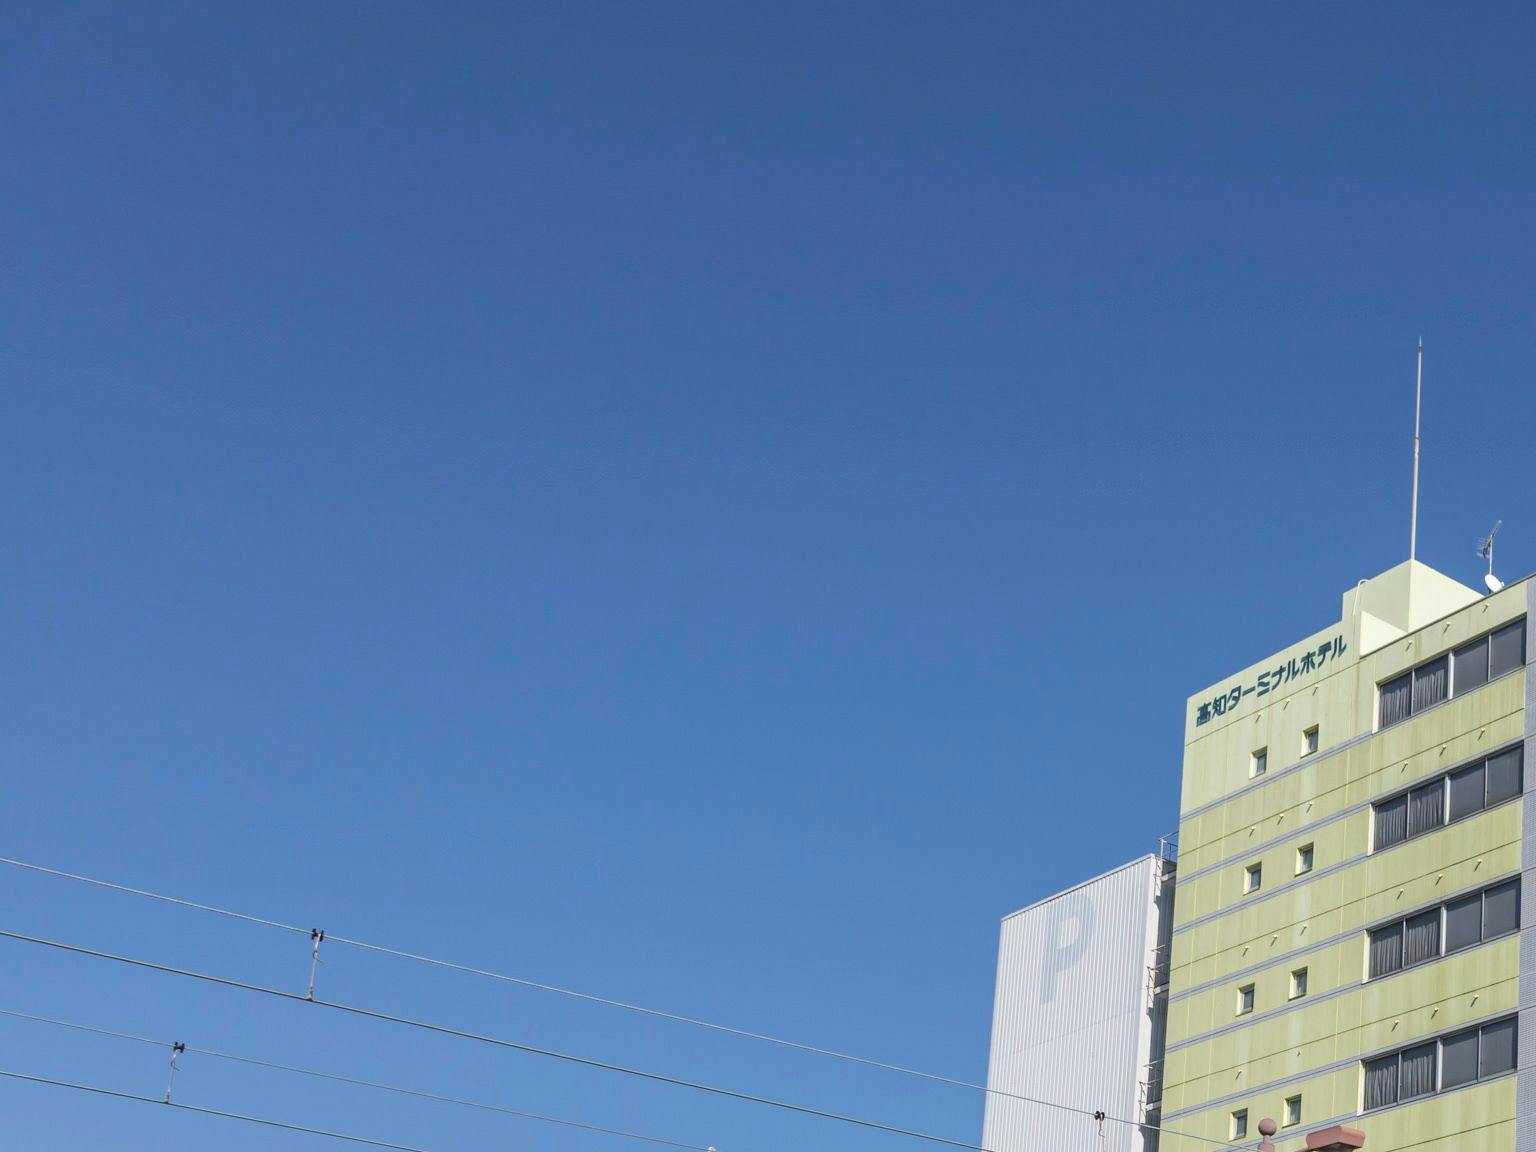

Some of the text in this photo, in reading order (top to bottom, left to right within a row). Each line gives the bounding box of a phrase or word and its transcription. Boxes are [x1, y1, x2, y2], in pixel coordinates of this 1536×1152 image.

[1196, 635, 1347, 727] 高知ターミナルホテル
[1040, 893, 1093, 1004] P
